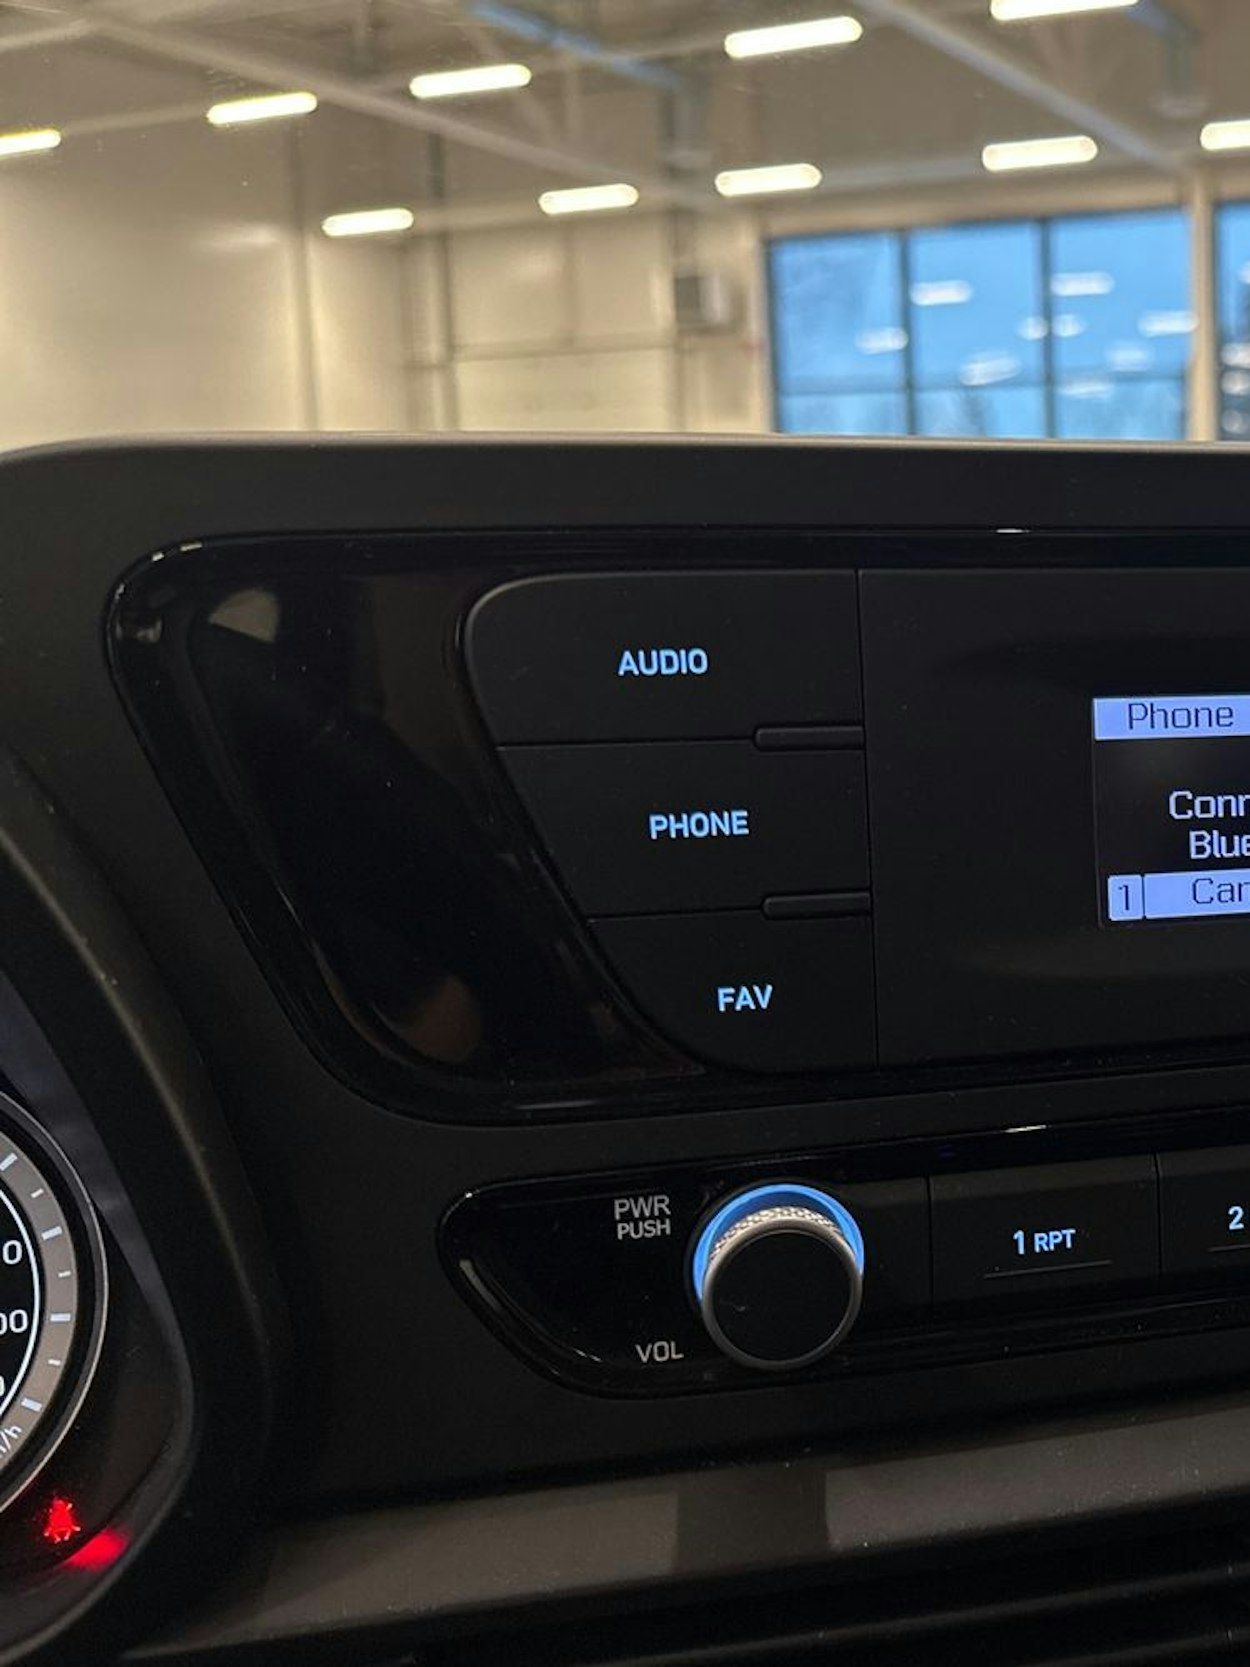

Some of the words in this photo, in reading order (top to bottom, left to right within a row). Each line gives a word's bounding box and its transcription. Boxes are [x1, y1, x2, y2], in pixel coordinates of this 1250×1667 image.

[618, 648, 708, 676] AUDIO
[1127, 703, 1234, 730] Phone
[649, 810, 750, 840] PHONE
[1119, 884, 1131, 911] 1
[717, 984, 773, 1012] FAV
[614, 1194, 672, 1221] PWR
[1228, 1205, 1245, 1231] 2
[616, 1218, 672, 1240] PUSH
[1012, 1229, 1026, 1255] 1
[1033, 1228, 1076, 1253] RPT
[635, 1340, 684, 1363] VOL
